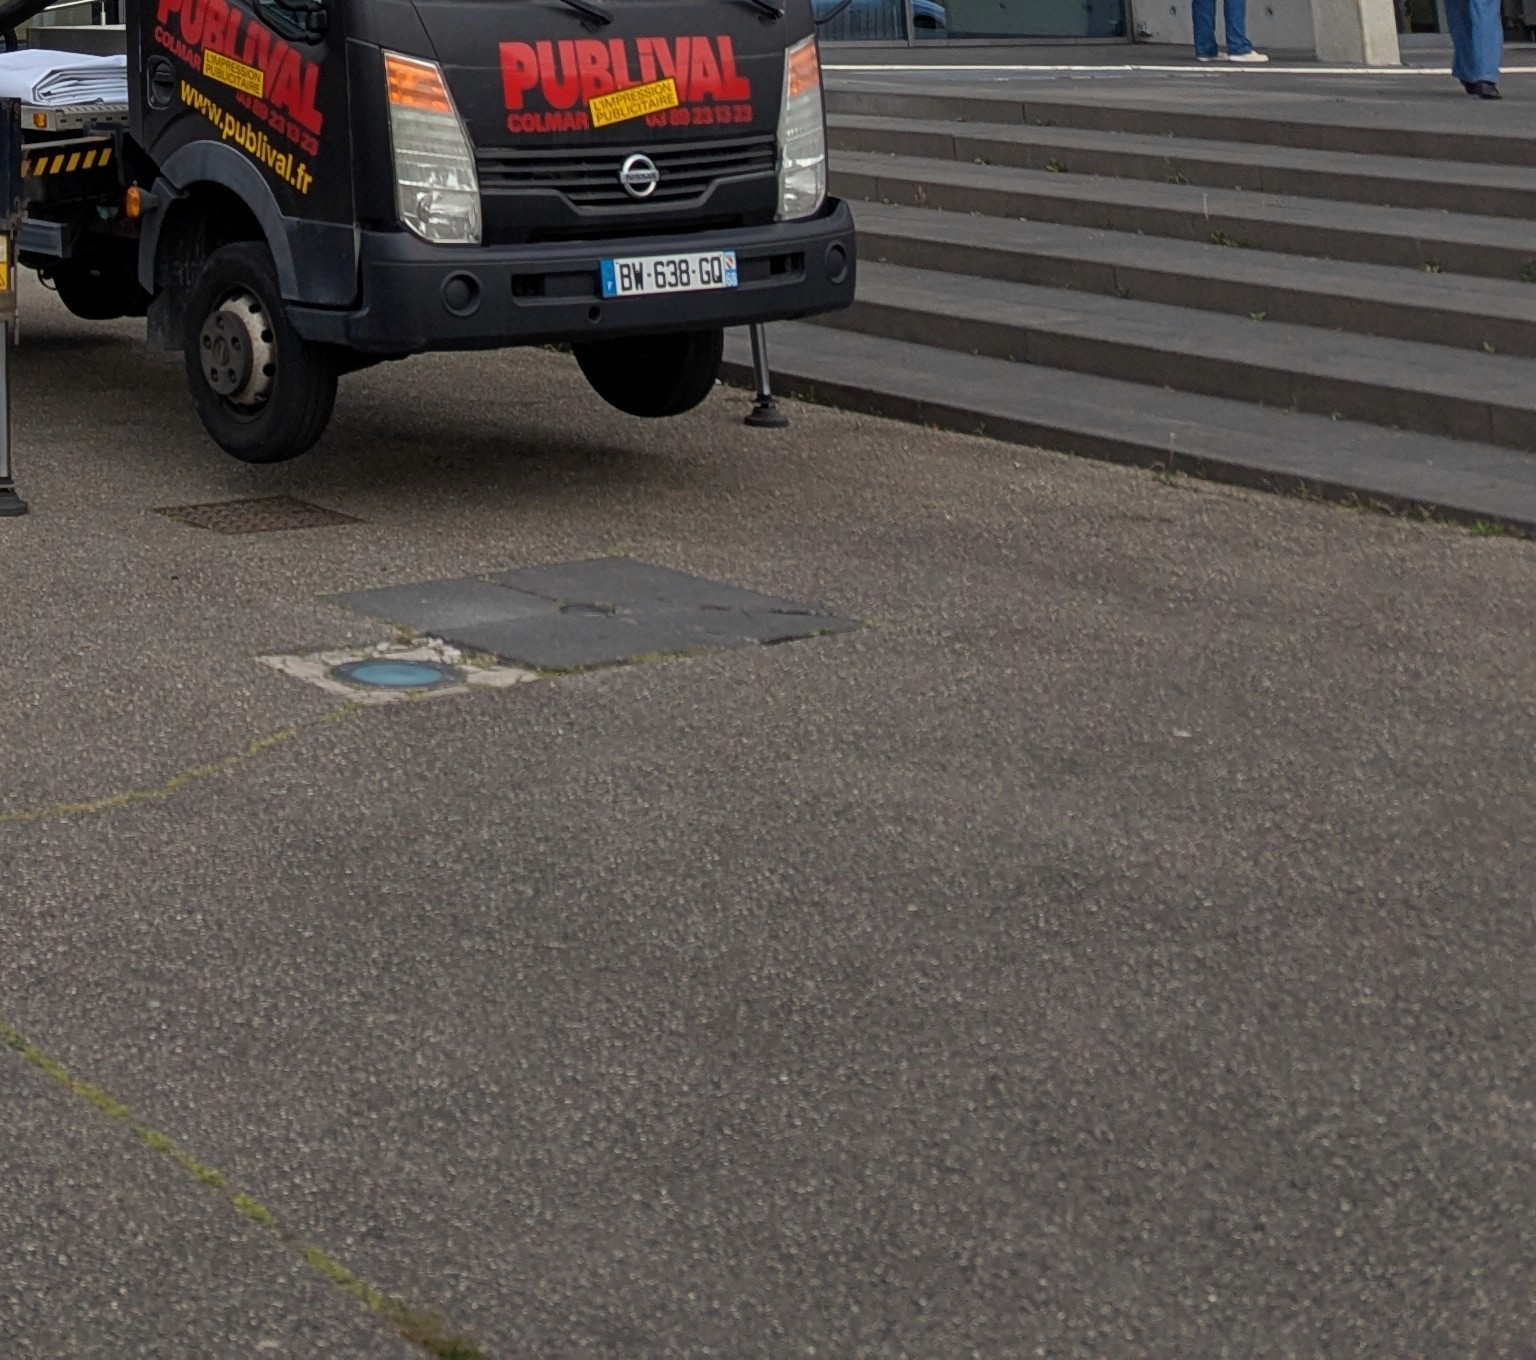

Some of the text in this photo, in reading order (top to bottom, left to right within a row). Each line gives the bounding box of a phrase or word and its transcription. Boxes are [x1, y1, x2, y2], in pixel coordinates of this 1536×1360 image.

[154, 25, 202, 73] COLMAR
[205, 61, 262, 97] PUBLICITAIRE
[592, 82, 673, 112] L'IMPRESSION
[594, 95, 676, 123] PUBLICITAIRE
[180, 80, 314, 195] www.publival.fr
[507, 111, 590, 134] COLMAR
